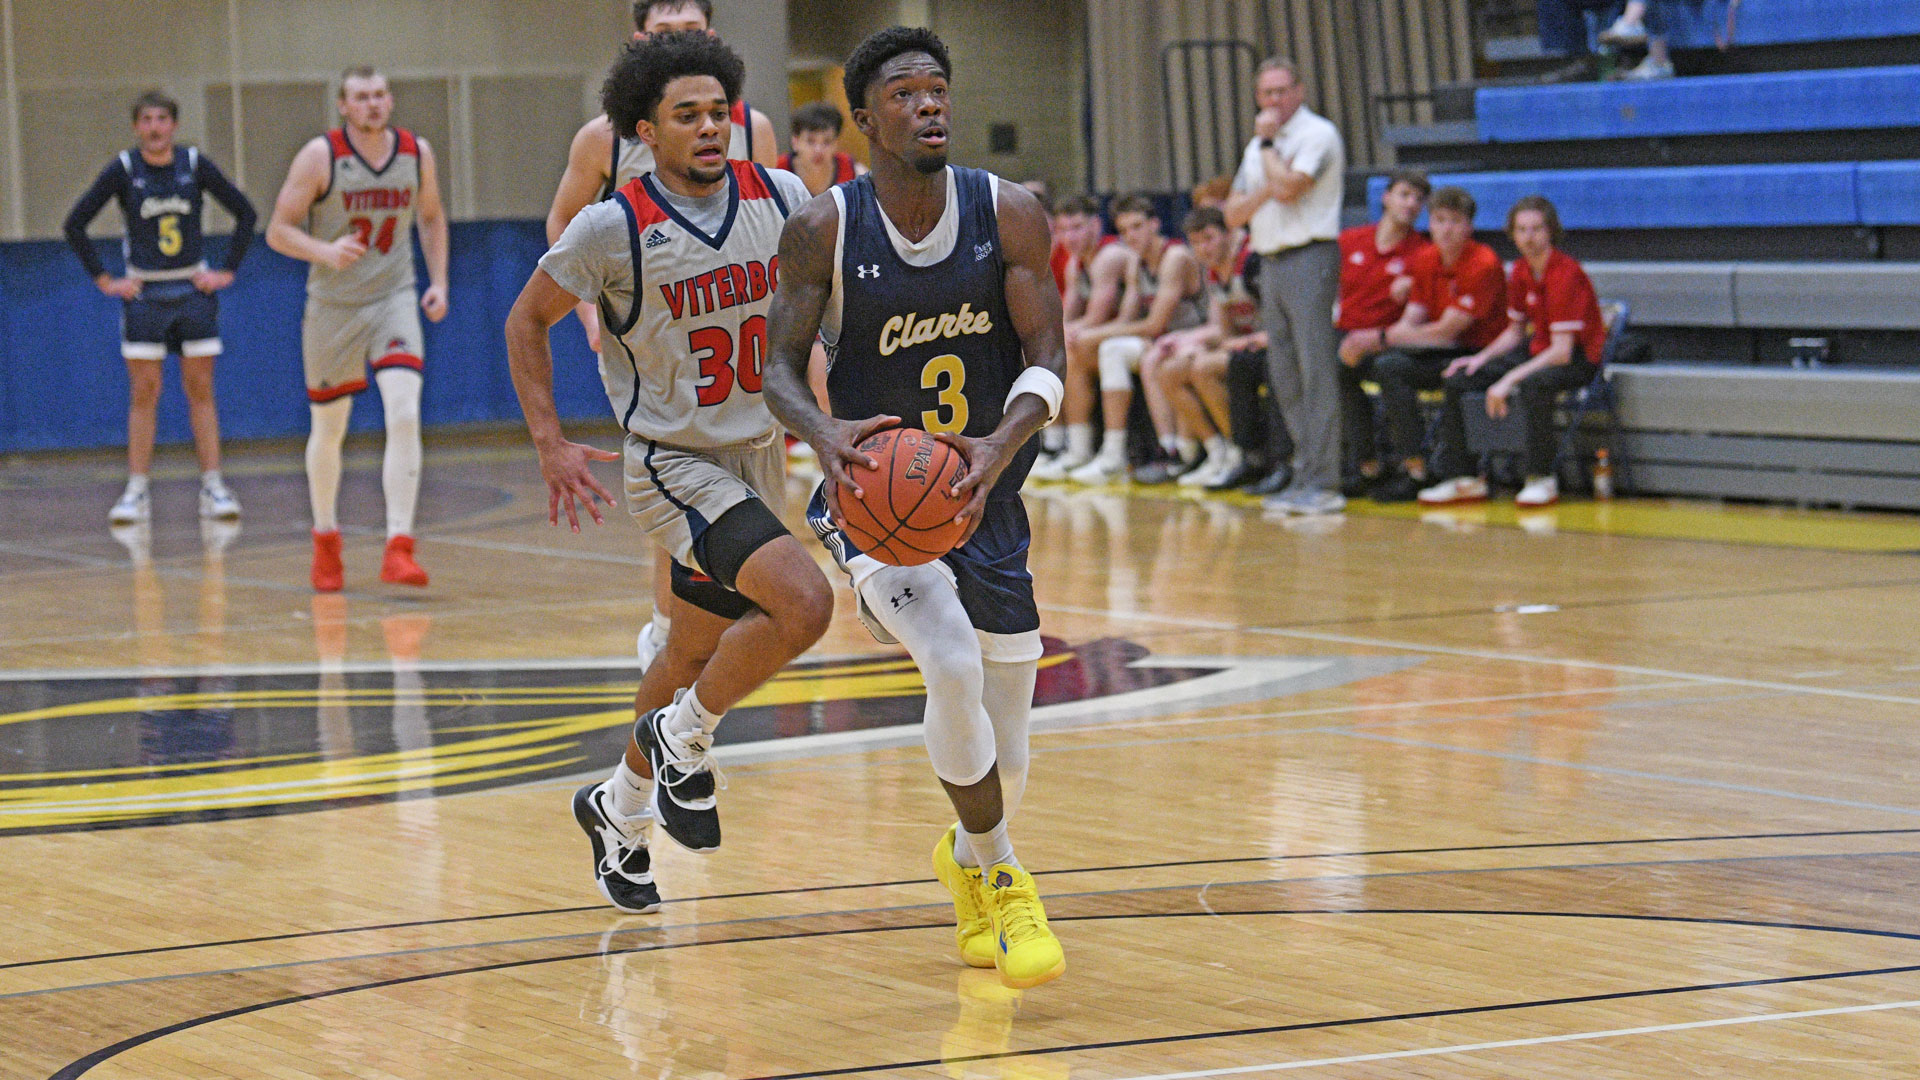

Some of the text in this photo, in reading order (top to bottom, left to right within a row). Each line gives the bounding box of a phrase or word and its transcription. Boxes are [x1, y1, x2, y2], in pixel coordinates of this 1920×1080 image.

[341, 187, 411, 212] VITERBO
[158, 215, 183, 256] 5
[645, 236, 671, 249] adidas
[879, 303, 993, 356] Clarke
[687, 314, 767, 407] 30
[920, 353, 969, 435] 3
[905, 432, 935, 486] SPALD
